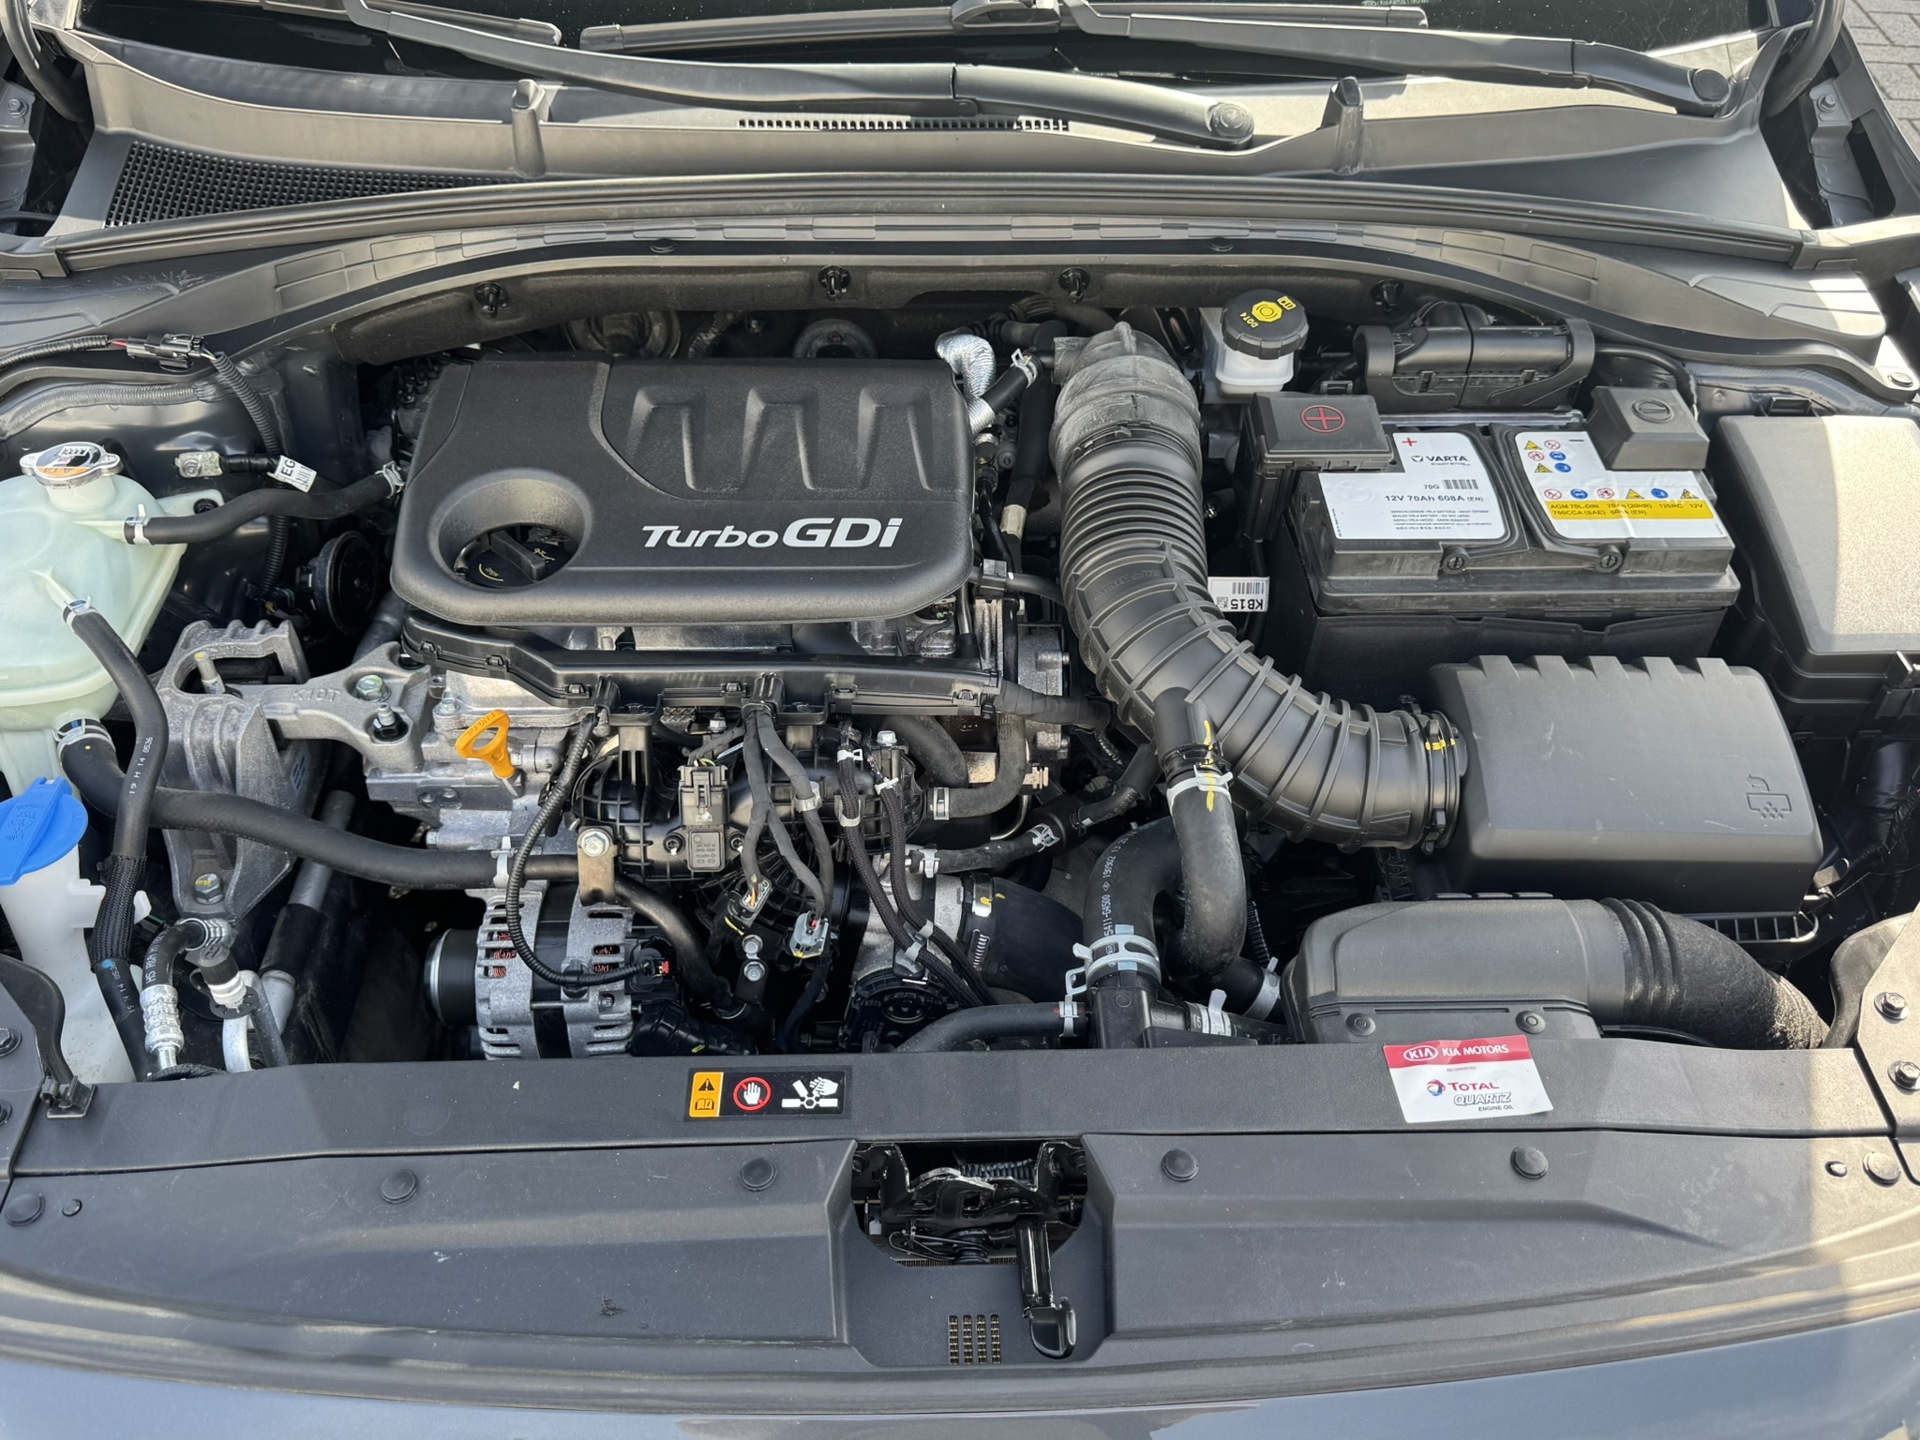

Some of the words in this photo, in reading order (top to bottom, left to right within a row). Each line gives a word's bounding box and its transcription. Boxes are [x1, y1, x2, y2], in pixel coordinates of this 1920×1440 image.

[1240, 312, 1259, 328] DOT4
[280, 459, 296, 477] EG
[1230, 598, 1264, 610] KB15
[1442, 1048, 1461, 1057] KIA
[1463, 1044, 1510, 1056] MOTORS
[1453, 1092, 1512, 1107] QUARTZ
